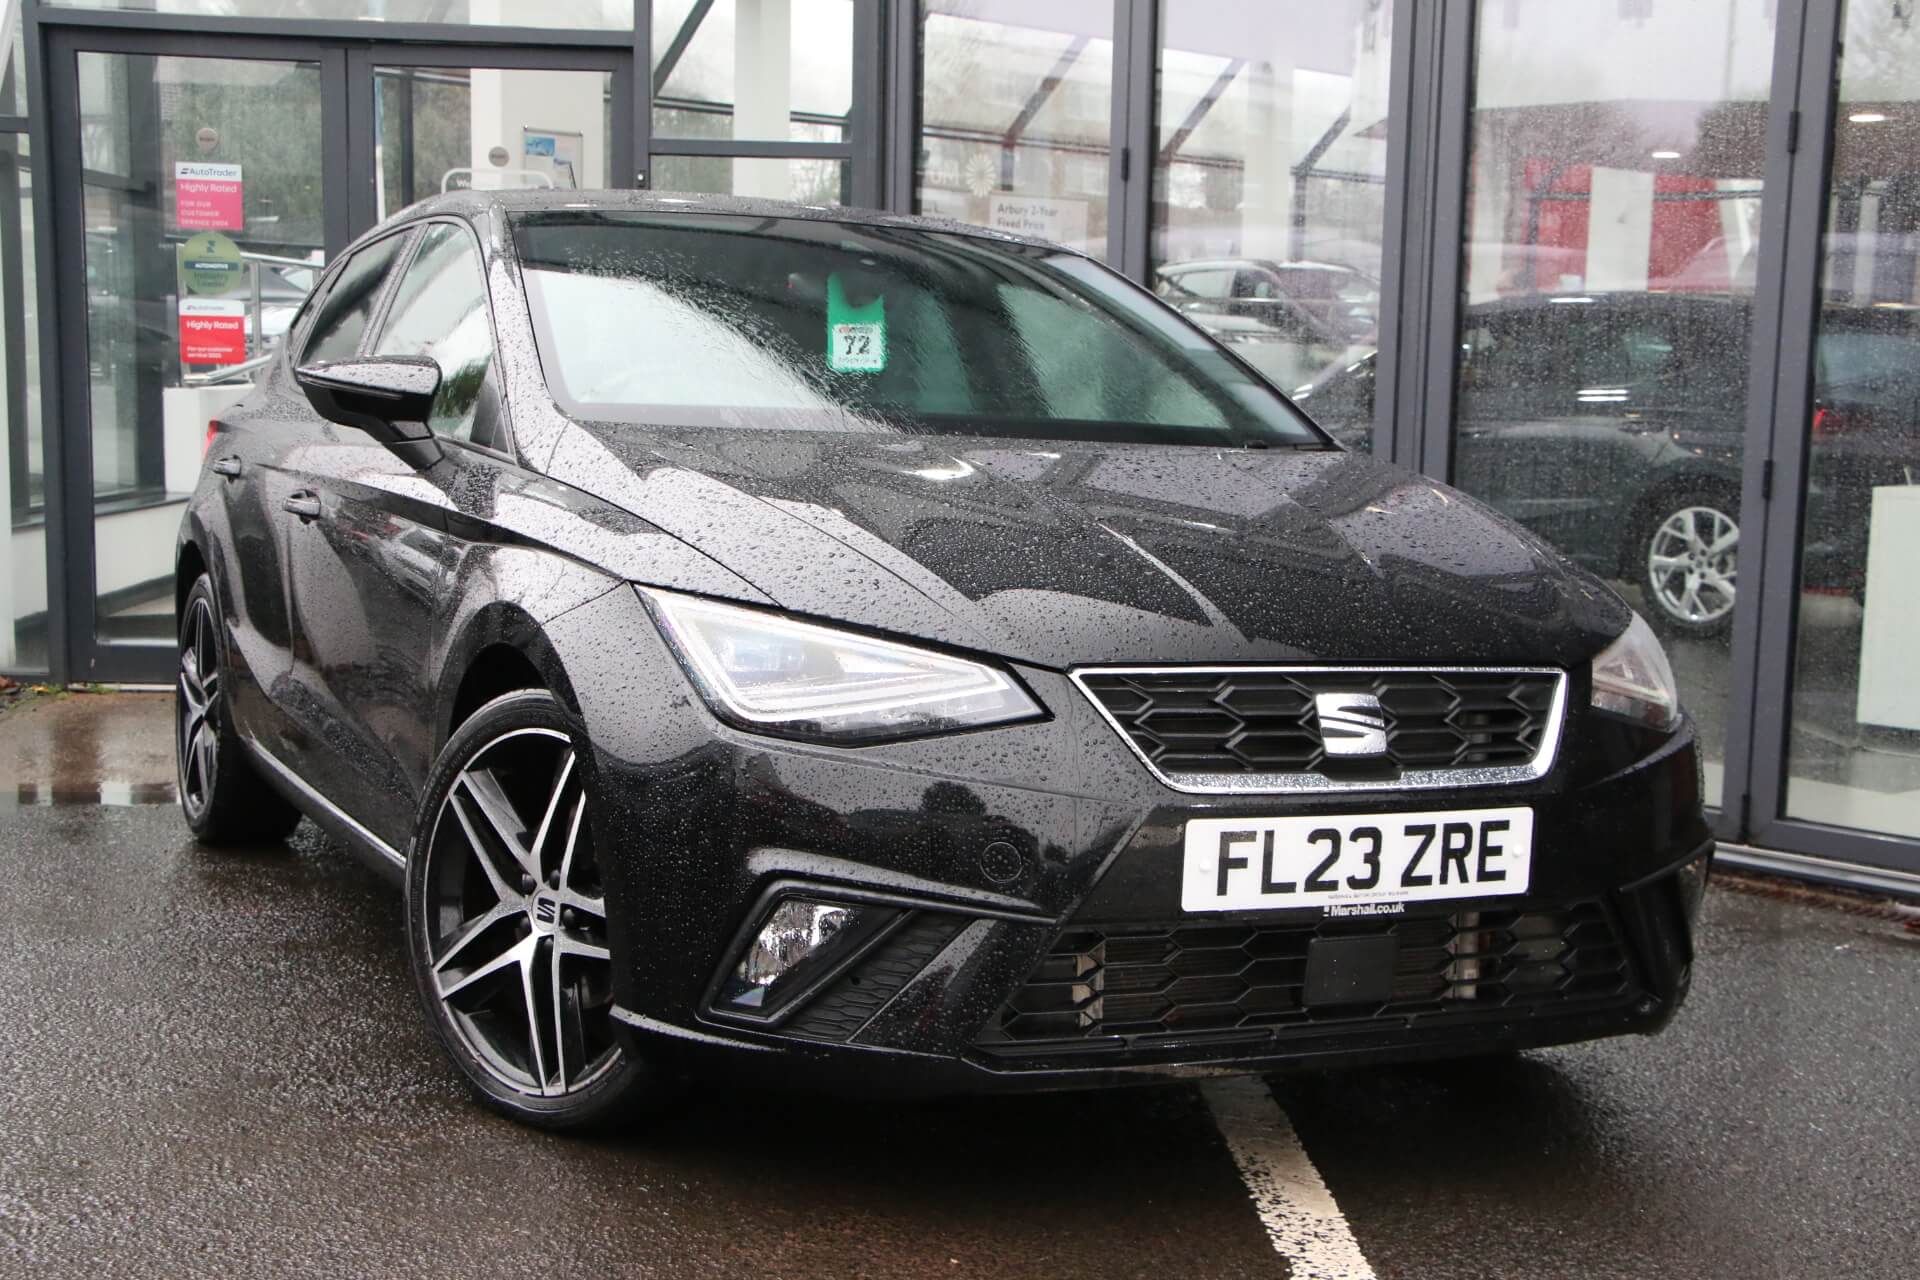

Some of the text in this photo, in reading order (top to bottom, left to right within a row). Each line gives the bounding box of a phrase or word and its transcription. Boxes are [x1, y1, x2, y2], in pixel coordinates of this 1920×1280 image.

[190, 167, 237, 177] AutoTrader
[180, 183, 237, 193] Highly Rated
[998, 203, 1028, 217] Arbury
[187, 320, 239, 330] Highly Rated
[844, 335, 871, 355] 72
[1217, 819, 1511, 897] FL23 ZRE
[1331, 901, 1405, 917] Marshall.co.uk
